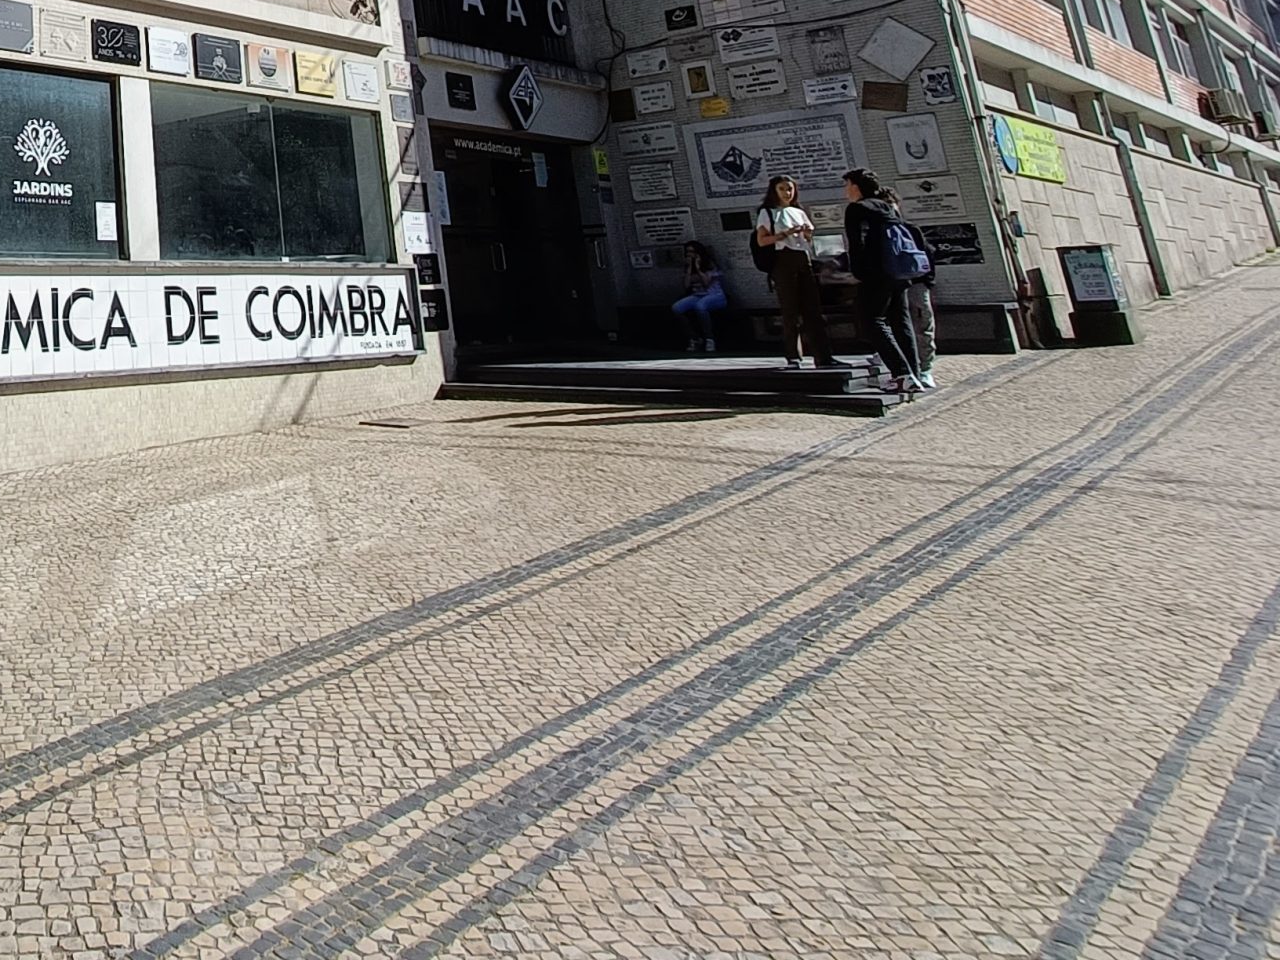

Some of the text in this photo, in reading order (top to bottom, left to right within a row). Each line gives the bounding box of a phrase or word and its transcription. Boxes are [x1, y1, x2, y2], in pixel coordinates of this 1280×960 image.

[453, 137, 523, 157] www.academica.pt
[13, 180, 73, 197] JARDINS
[164, 286, 221, 345] DE
[245, 284, 418, 341] COIMBRA
